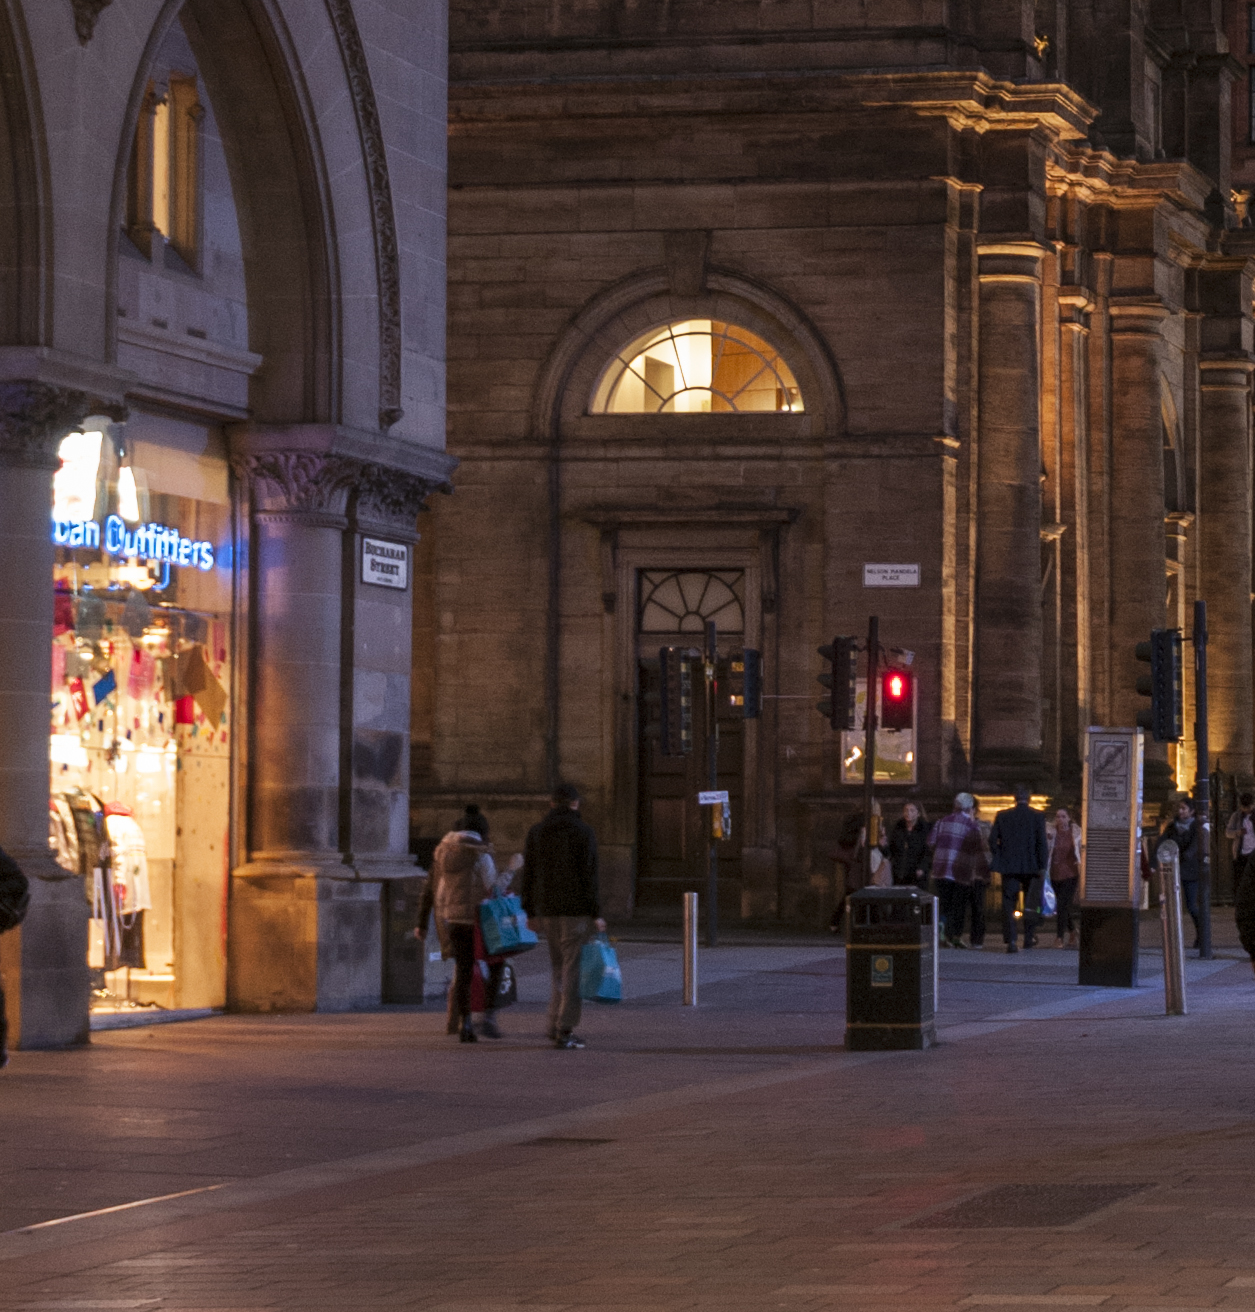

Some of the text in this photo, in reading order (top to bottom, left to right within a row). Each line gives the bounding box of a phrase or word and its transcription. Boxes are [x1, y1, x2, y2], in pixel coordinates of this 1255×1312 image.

[52, 513, 215, 572] ban Outfitters
[370, 558, 400, 577] STREET
